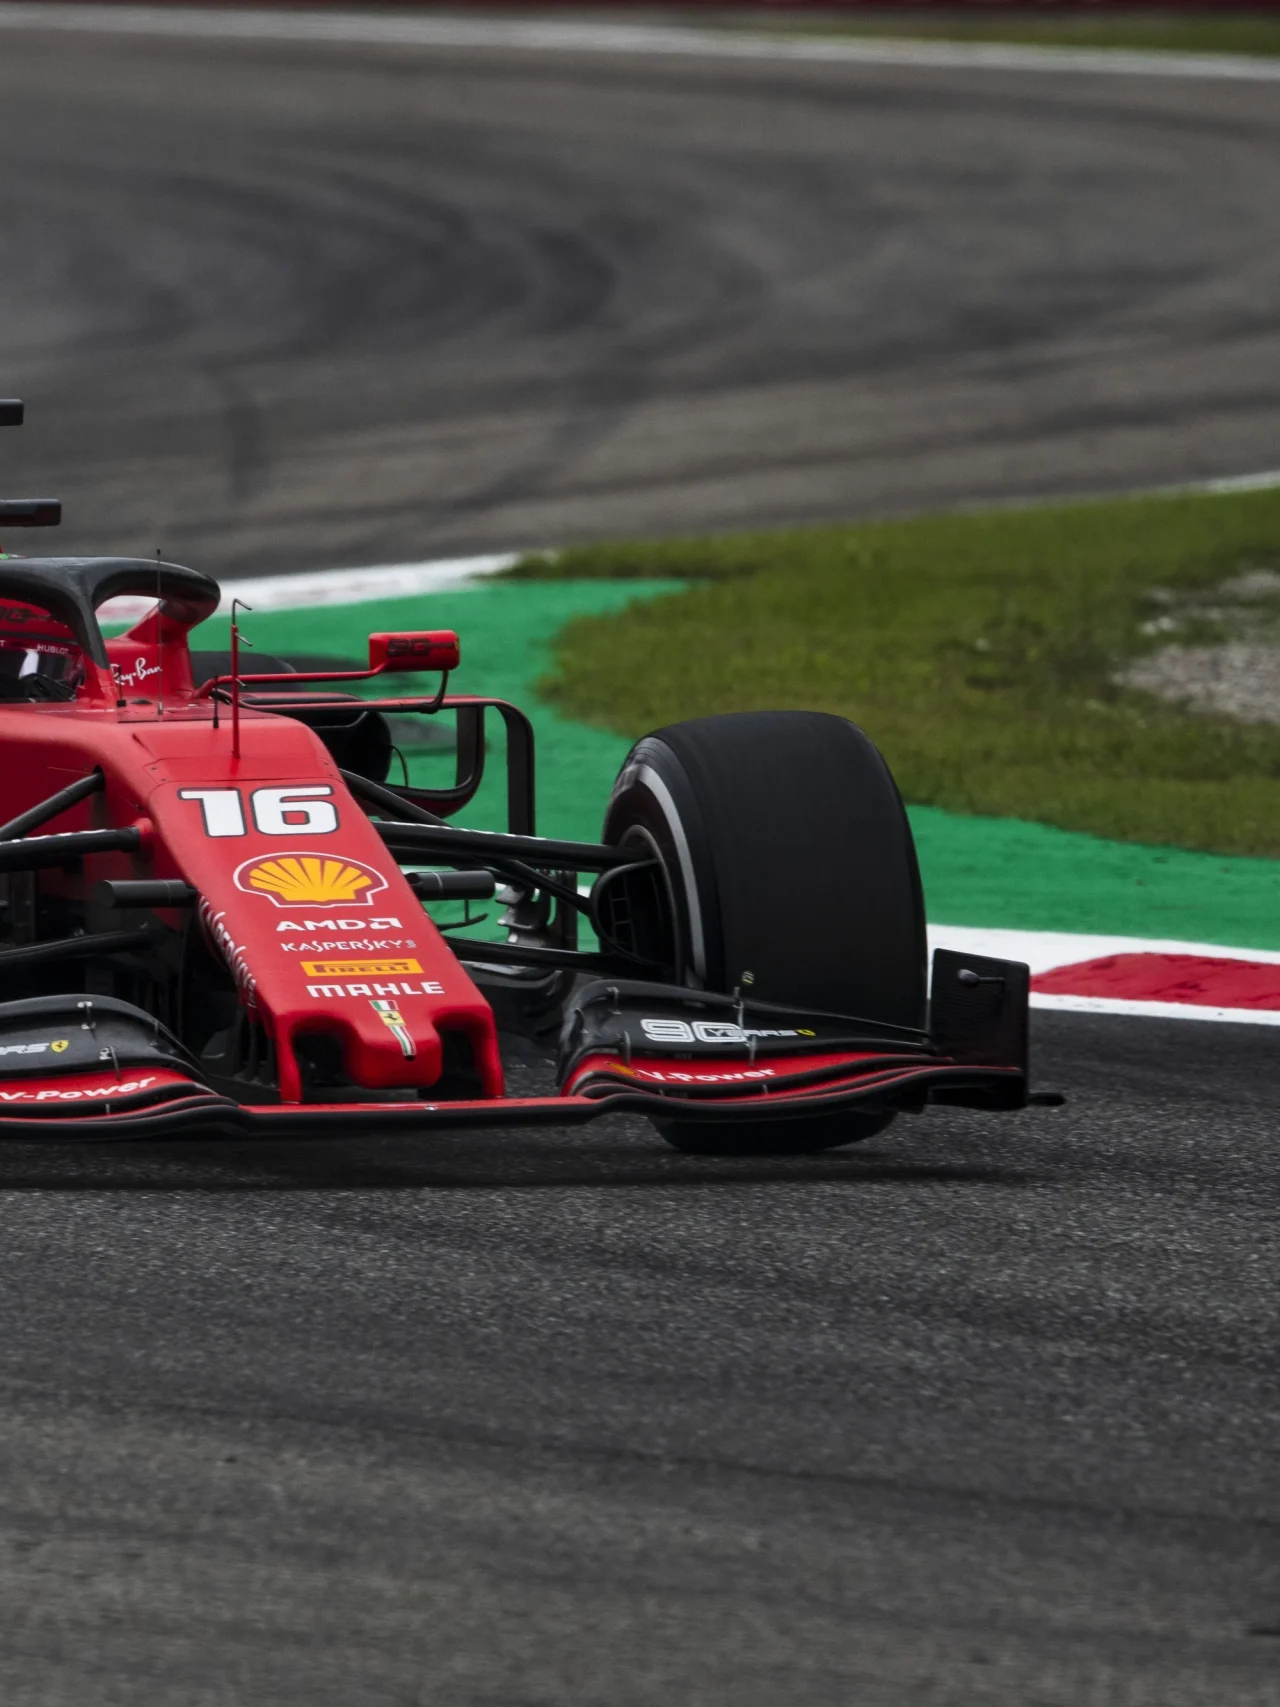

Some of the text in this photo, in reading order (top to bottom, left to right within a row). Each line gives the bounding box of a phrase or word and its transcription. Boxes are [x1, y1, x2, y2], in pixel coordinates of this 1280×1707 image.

[36, 644, 69, 656] HUBLOT
[178, 785, 340, 837] 16
[276, 919, 368, 931] AMD
[280, 938, 402, 952] KASPERSKY
[312, 962, 411, 974] PIRELLI
[306, 982, 445, 998] MAHLE
[640, 1018, 746, 1043] 90
